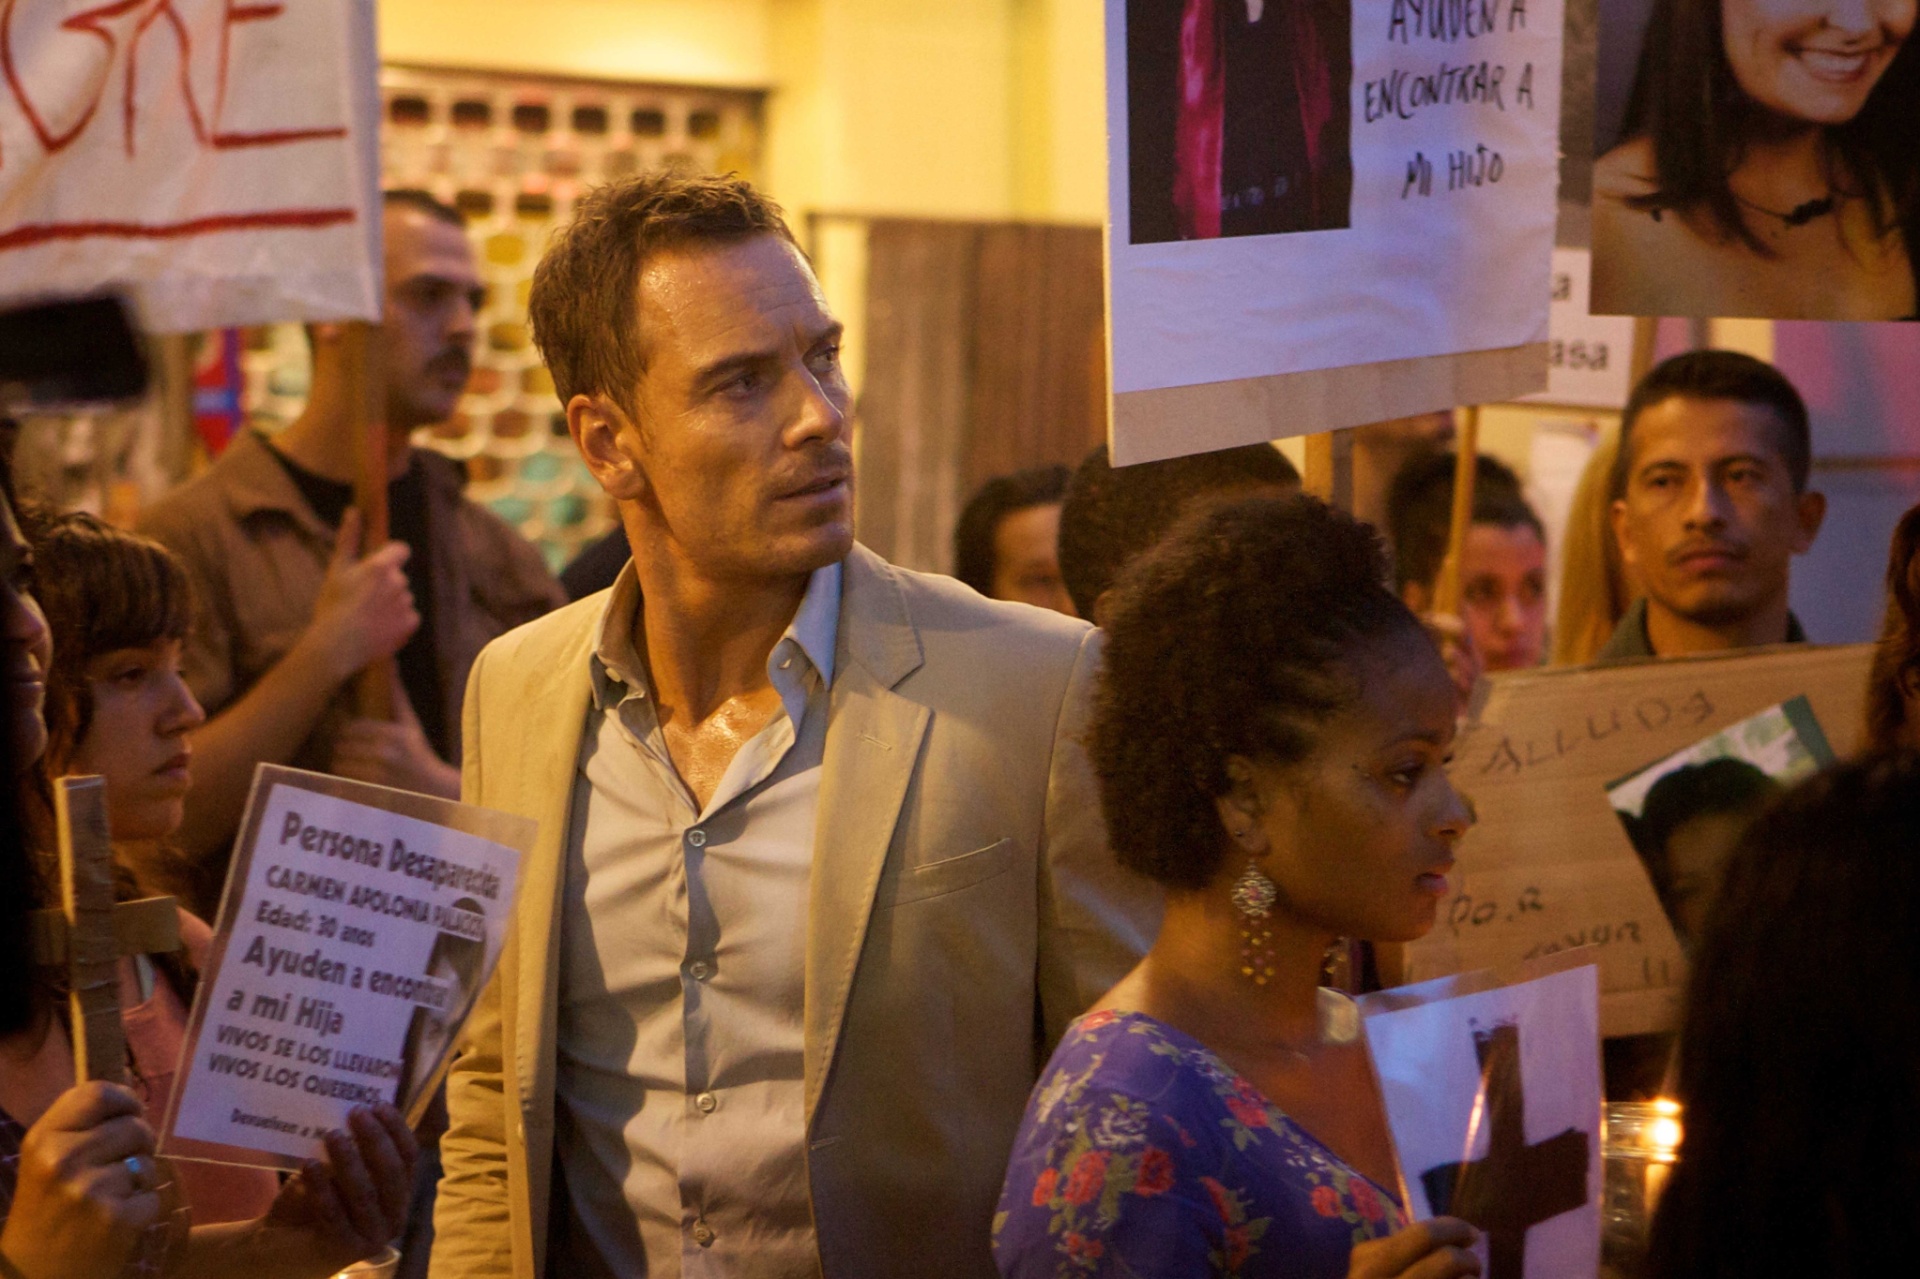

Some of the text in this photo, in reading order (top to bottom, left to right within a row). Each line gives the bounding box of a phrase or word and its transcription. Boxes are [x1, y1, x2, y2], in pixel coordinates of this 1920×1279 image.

[1388, 0, 1526, 44] AYUDEN A
[1365, 61, 1535, 123] ENCONTRAR A
[1401, 143, 1504, 200] MI HIJO
[279, 811, 383, 868] Persona
[266, 865, 347, 900] CARMEN
[254, 900, 312, 932] Edad:
[242, 935, 347, 985] Ayuden
[351, 967, 363, 988] a
[227, 990, 344, 1036] a mi Hija
[217, 1024, 272, 1051] VIVOS
[273, 1038, 296, 1056] SE
[297, 1043, 332, 1066] LOS
[209, 1053, 262, 1079] VIVOS
[262, 1065, 301, 1088] LOS
